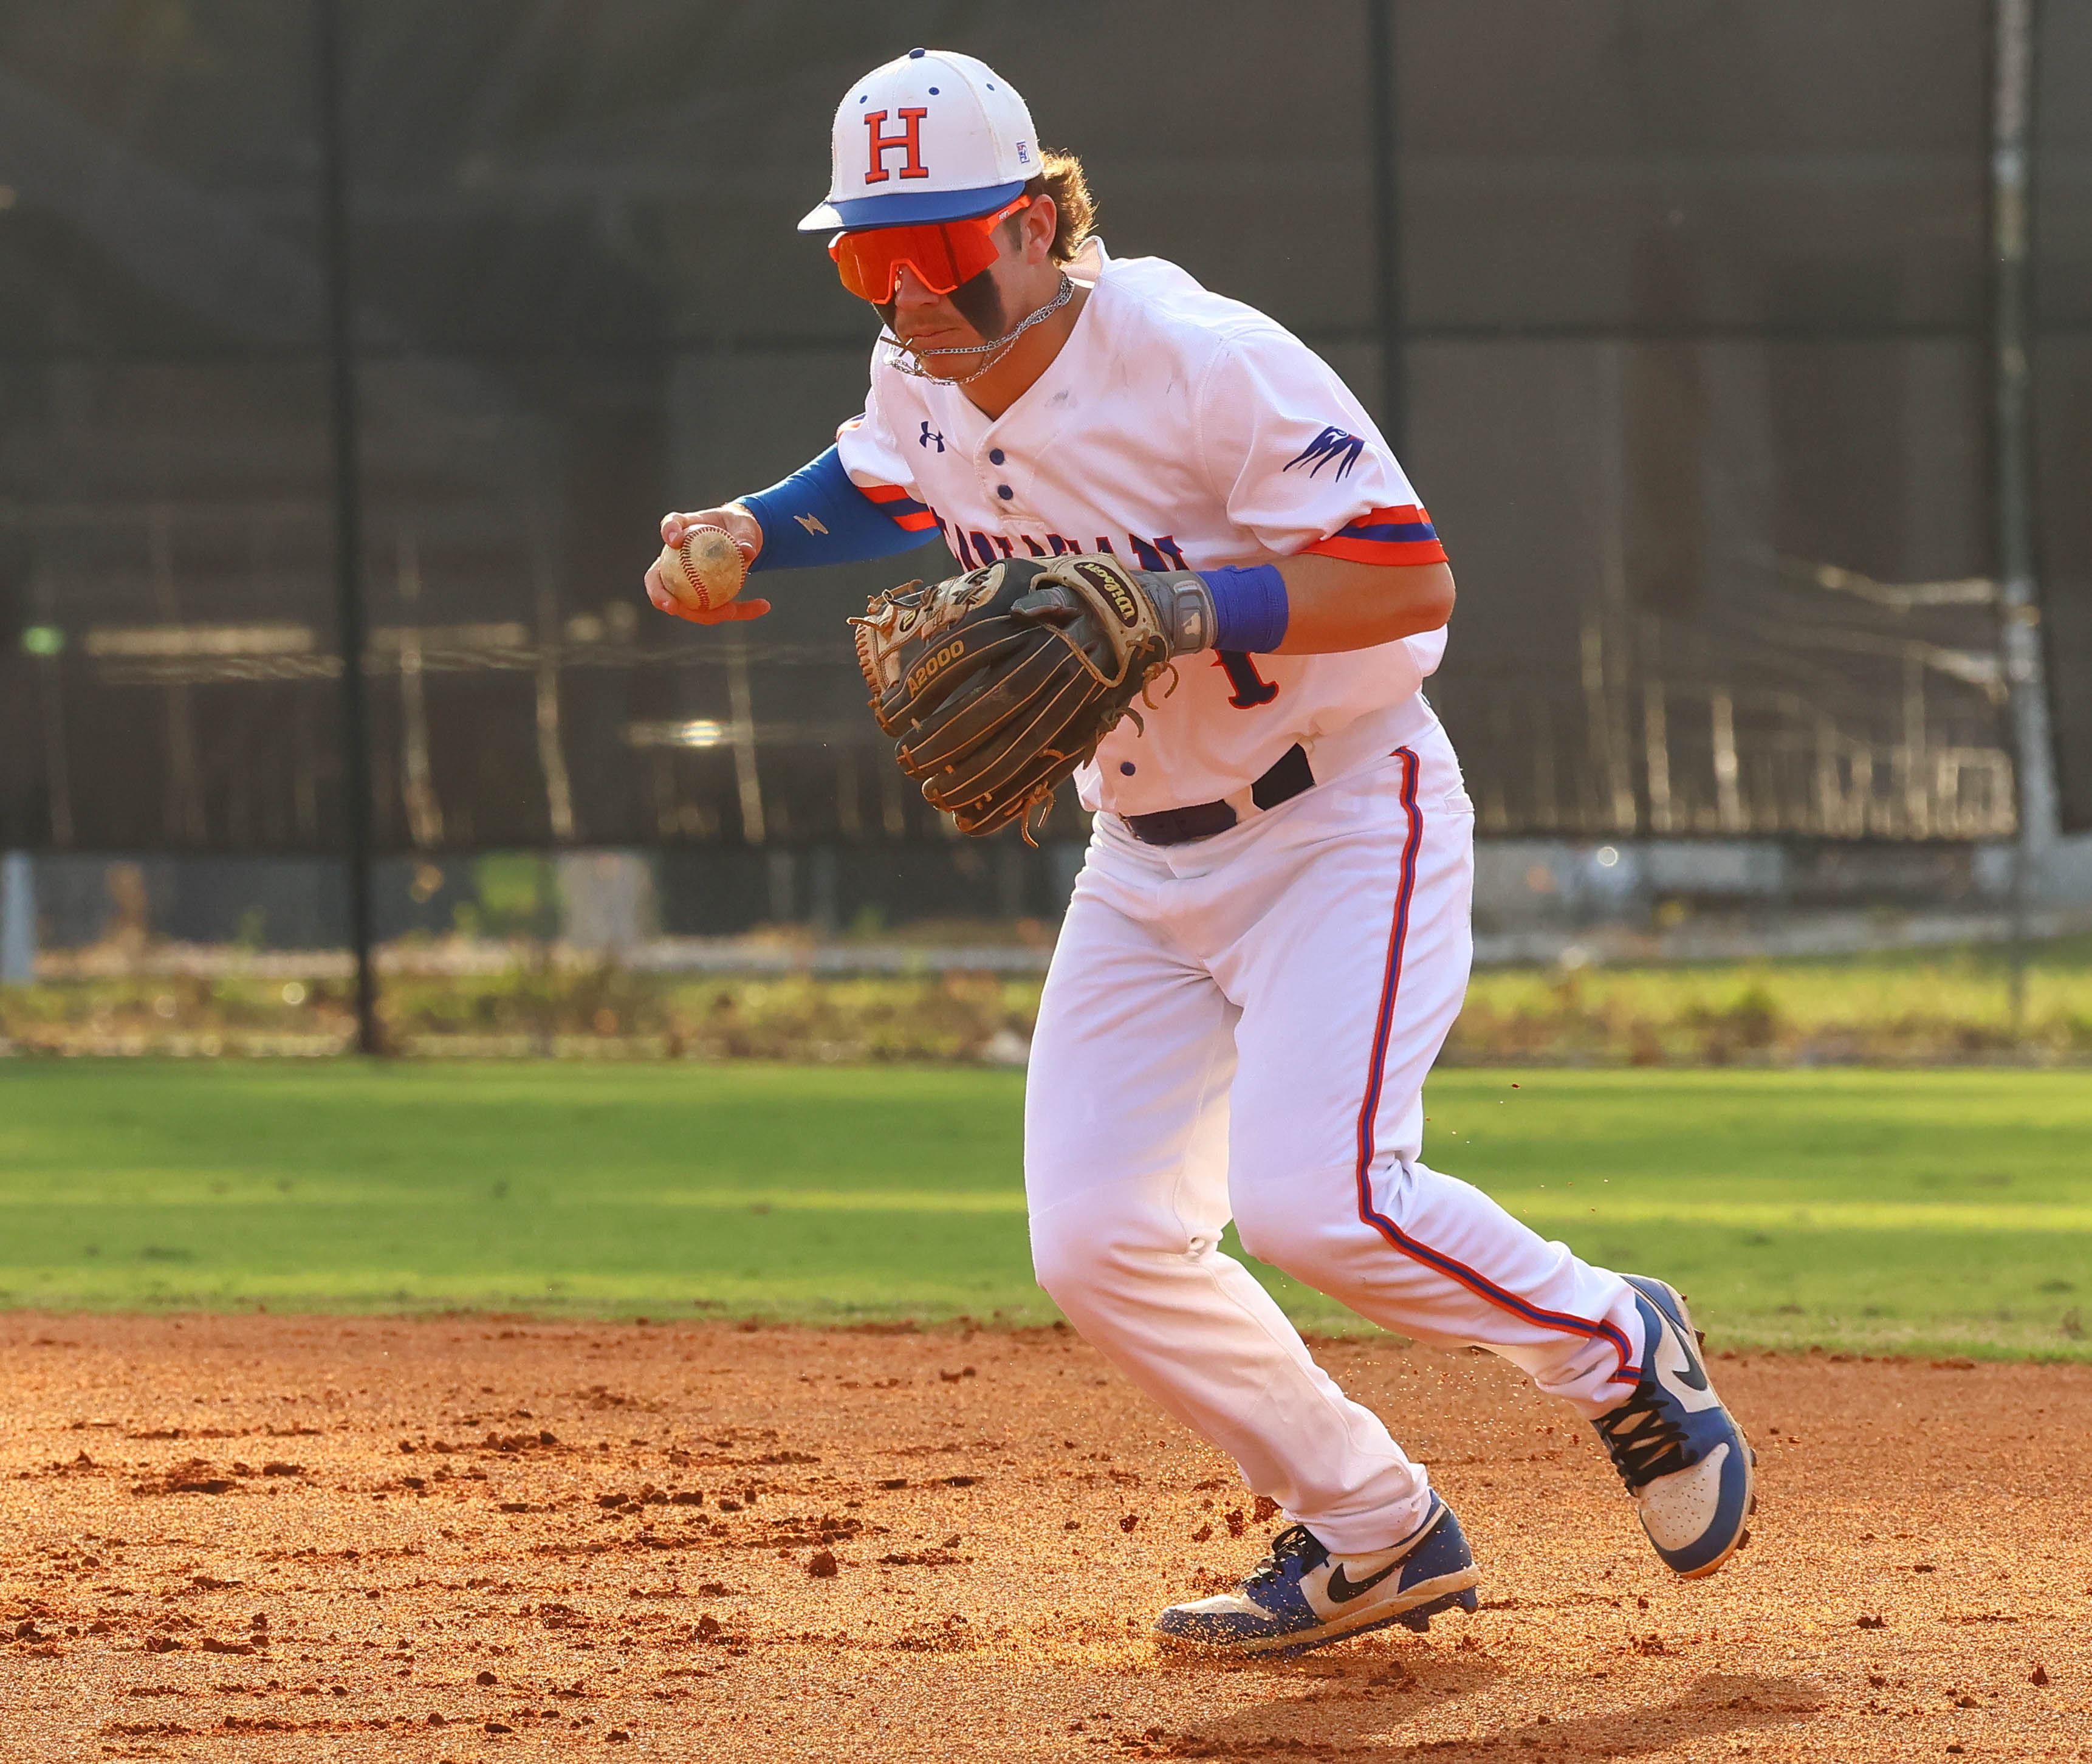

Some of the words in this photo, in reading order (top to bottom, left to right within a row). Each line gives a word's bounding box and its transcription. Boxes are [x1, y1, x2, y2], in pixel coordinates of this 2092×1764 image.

[864, 107, 928, 185] H
[1083, 563, 1136, 620] Wilson
[907, 640, 964, 698] A2000
